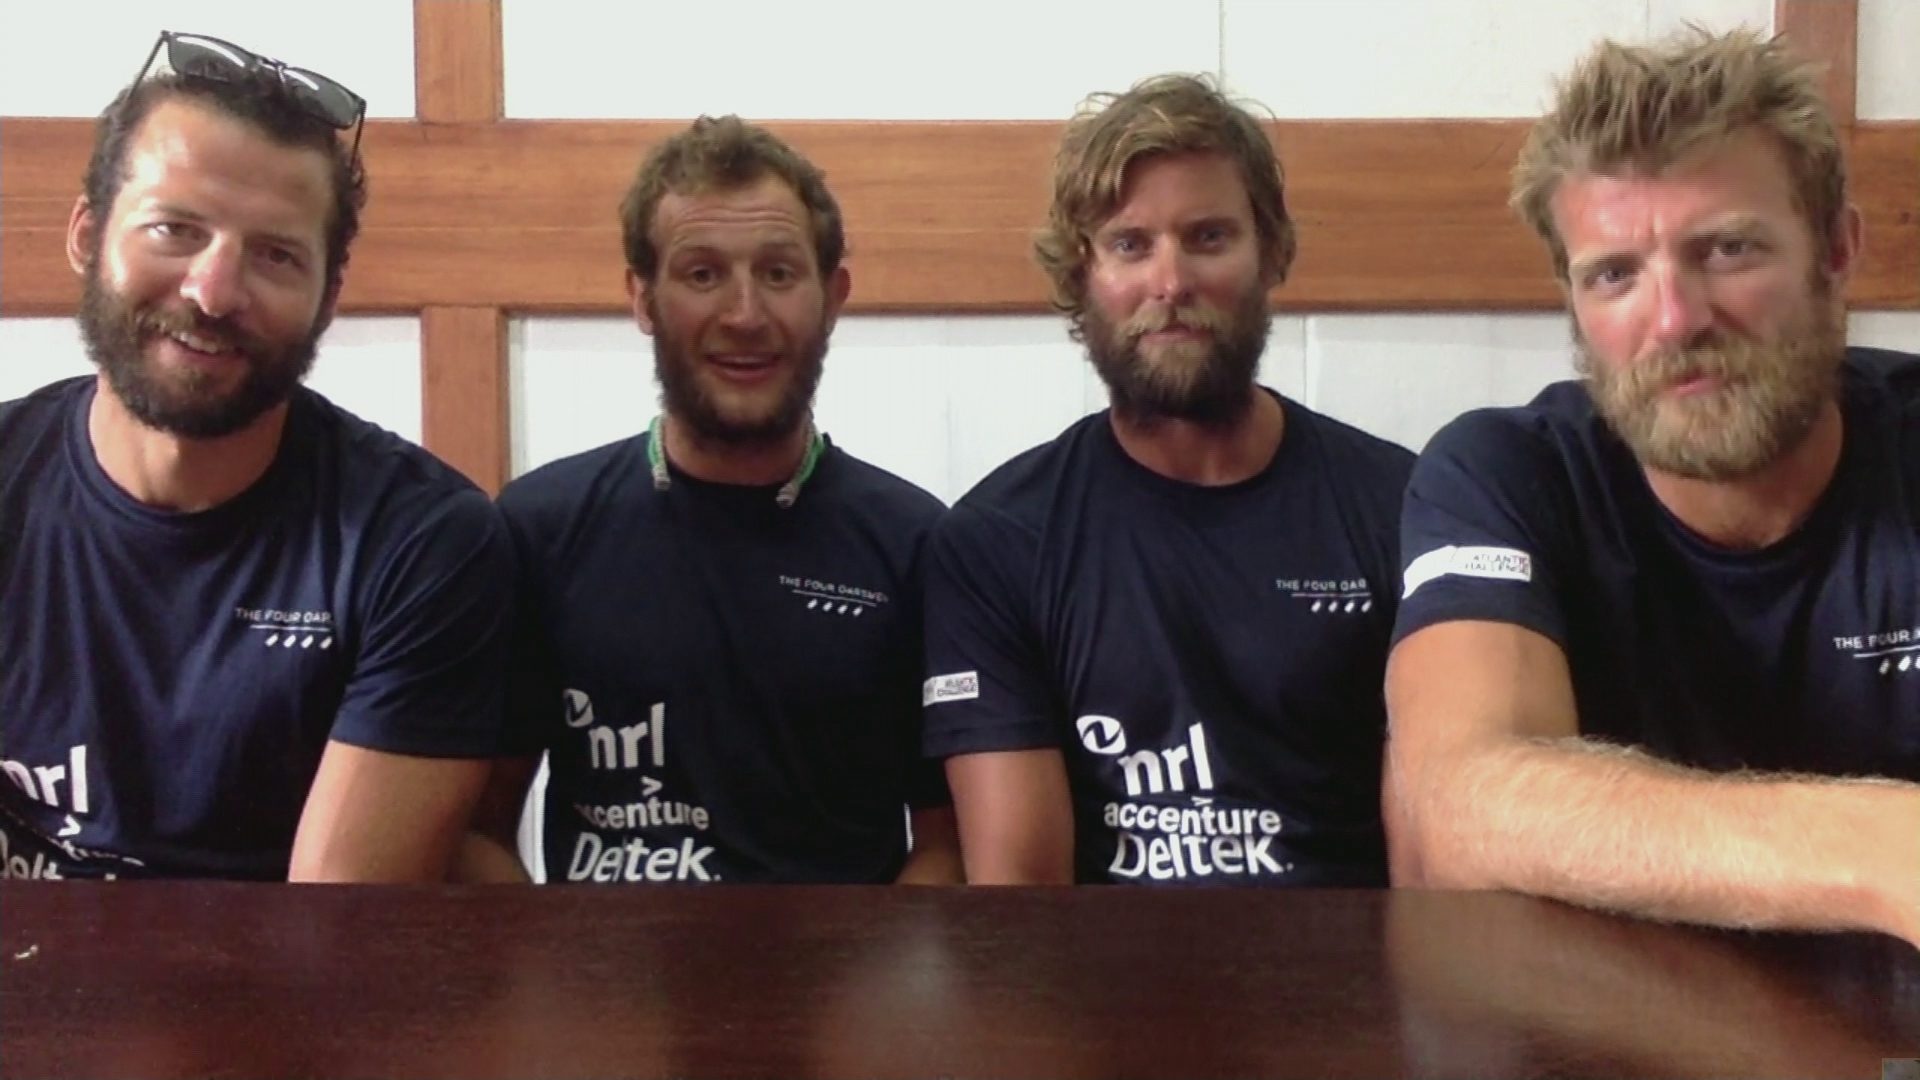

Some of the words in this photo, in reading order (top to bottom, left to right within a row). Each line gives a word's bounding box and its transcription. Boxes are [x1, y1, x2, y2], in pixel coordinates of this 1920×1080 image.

[804, 579, 835, 592] FOUR
[1276, 578, 1300, 591] THE
[1303, 580, 1336, 591] FOUR
[235, 606, 262, 621] THE
[264, 609, 301, 623] FOUR
[1833, 636, 1863, 649] THE
[1867, 629, 1910, 648] FOUR
[589, 702, 665, 769] nrl
[1118, 722, 1213, 796] nrl
[1104, 802, 1282, 836] accenture
